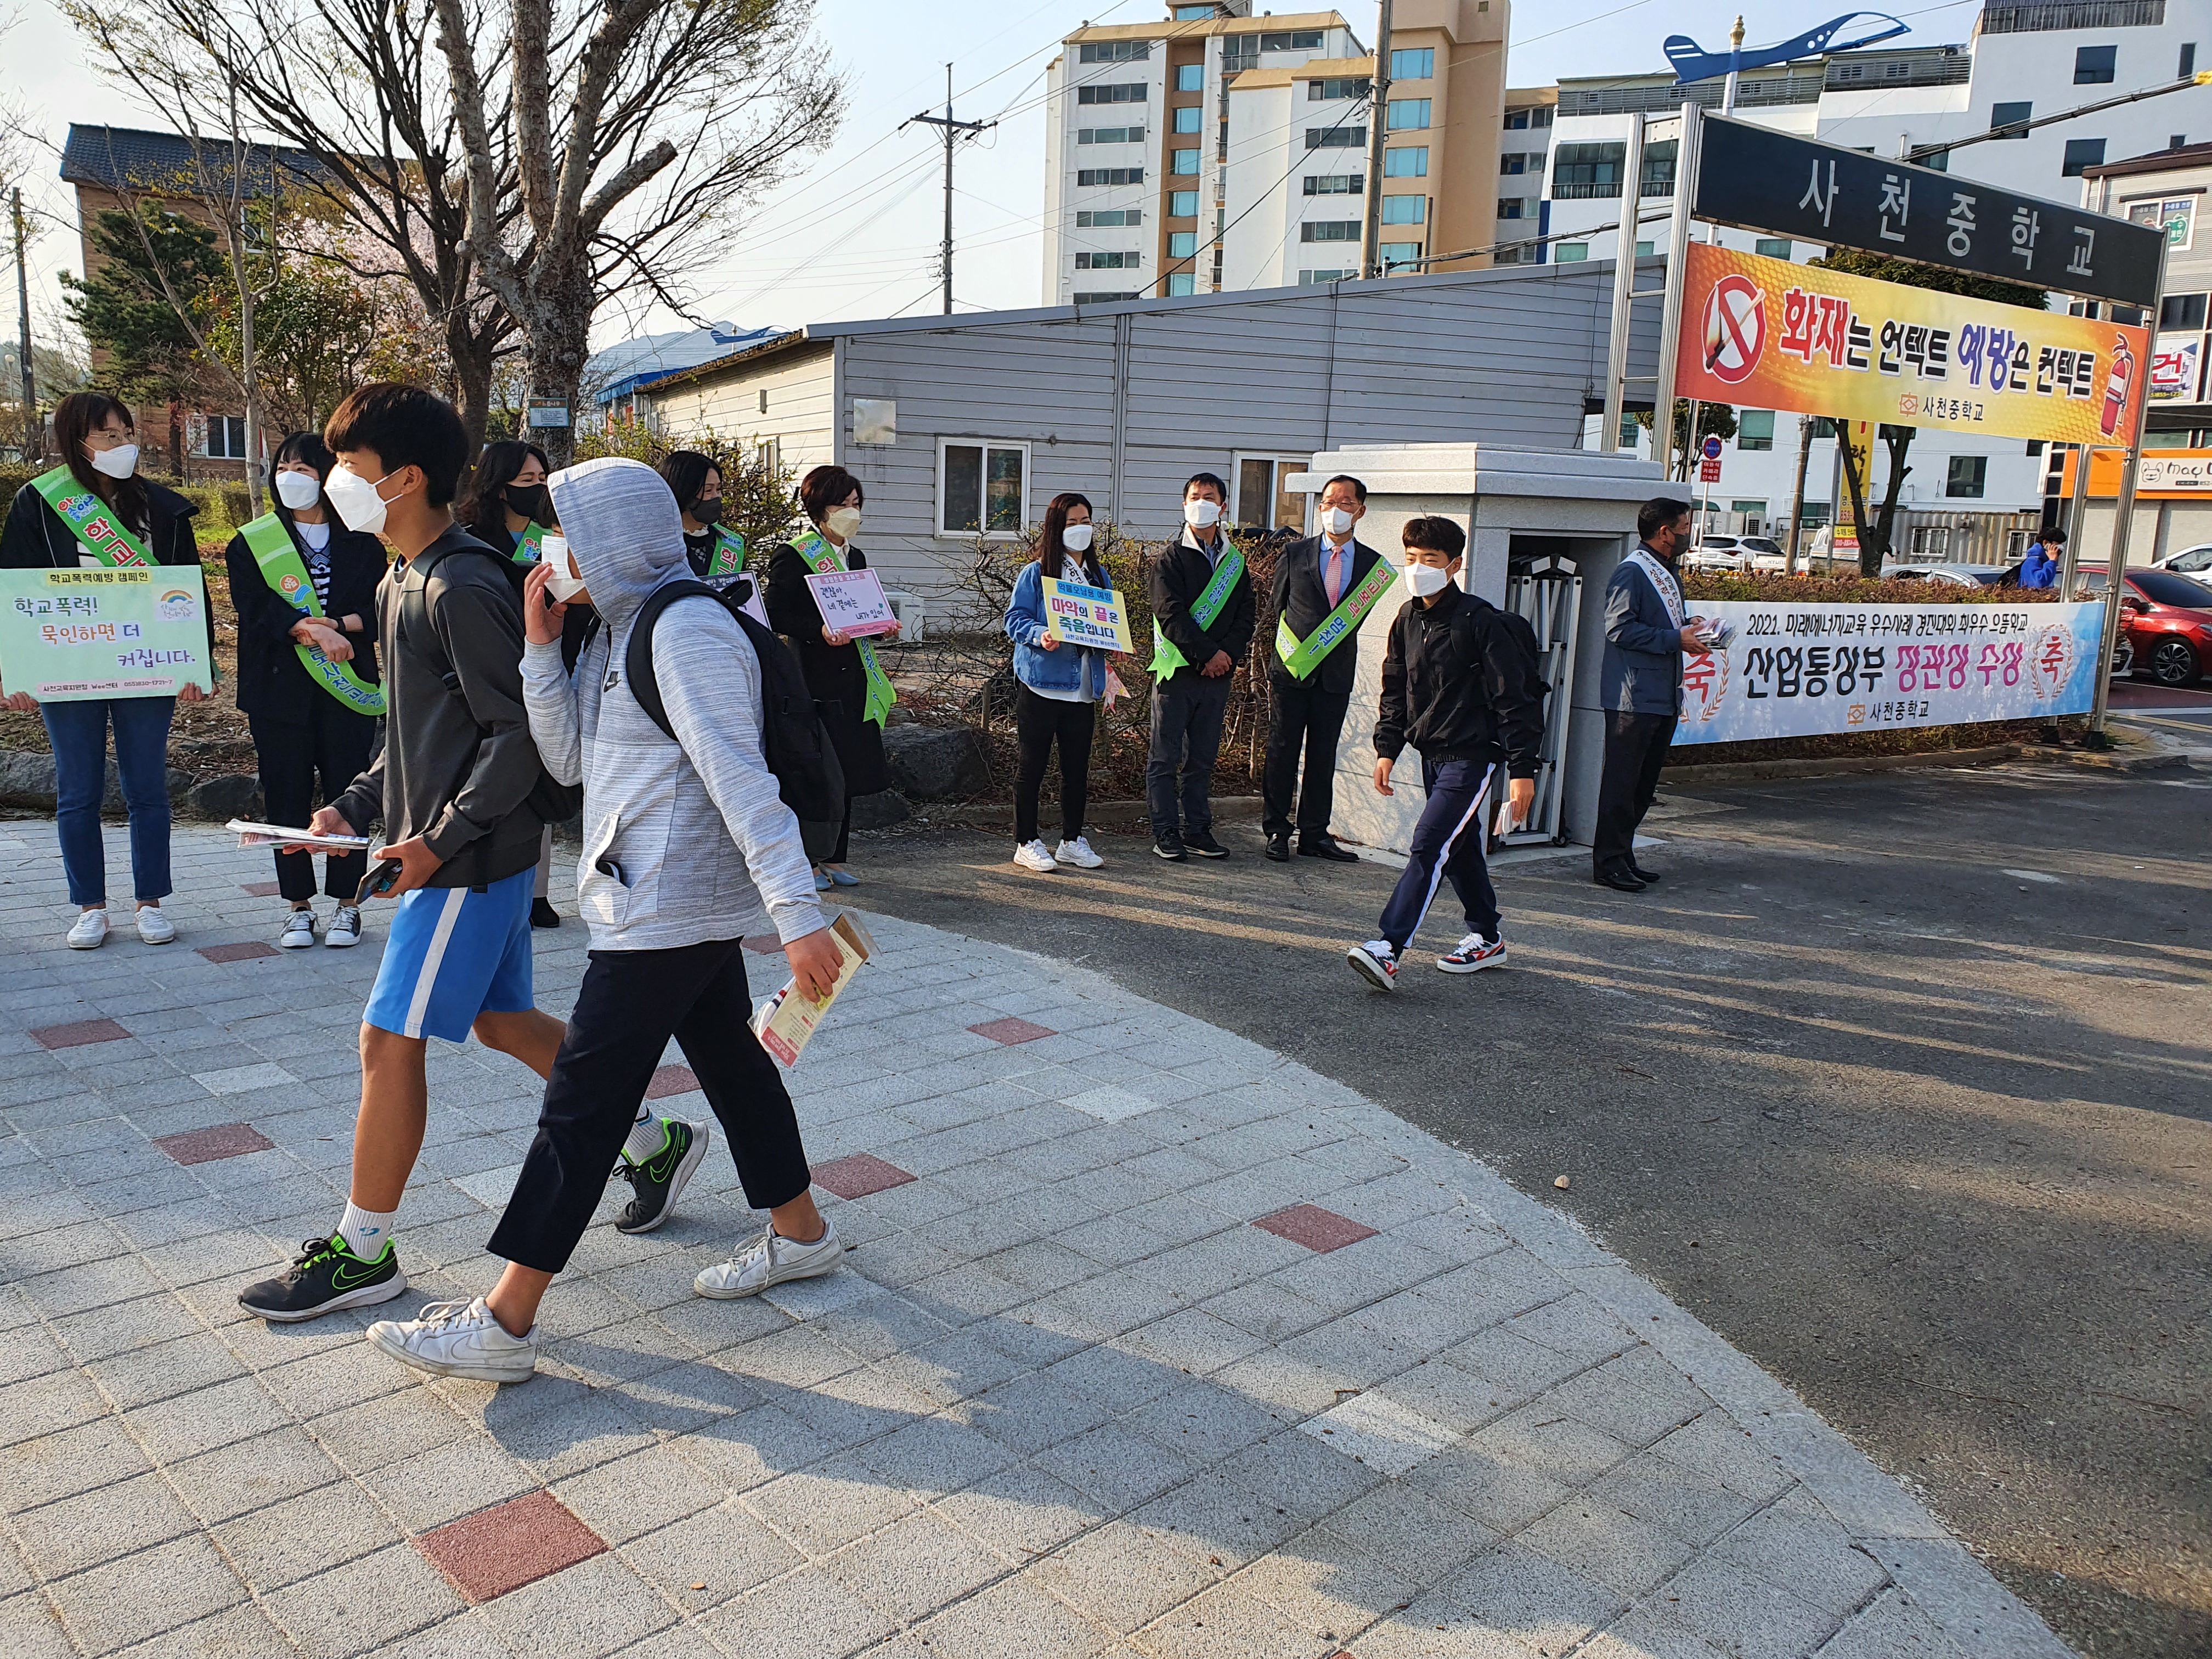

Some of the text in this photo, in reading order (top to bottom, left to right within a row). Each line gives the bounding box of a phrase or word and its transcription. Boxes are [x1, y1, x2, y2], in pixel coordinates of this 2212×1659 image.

[1799, 159, 2096, 276] 사천중학교
[1779, 288, 2096, 397] 화재는 언텍트 예방은 컨텍트
[1922, 396, 1984, 421] 사천중학교
[49, 572, 149, 584] 학교폭력예방 캠페인
[14, 597, 99, 618] 학교폭력!
[1097, 590, 1112, 602] 예방
[1051, 597, 1119, 624] 마약의 끝은
[1308, 568, 1390, 655] 학교폭력 멈춰!
[1667, 599, 1680, 626] OUT
[41, 623, 140, 645] 묵인하면 더
[1058, 615, 1115, 640] 죽음입니다
[1746, 613, 1780, 636] 2021.
[1785, 613, 1867, 637] 미래에너지교육
[1869, 613, 1914, 637] 우수사례
[1915, 613, 1957, 636] 경진대회
[1957, 612, 1989, 636] 최우수
[117, 648, 196, 668] 커집니다.
[1743, 645, 1886, 699] 산업통상부
[1976, 642, 2024, 687] 수상
[2040, 636, 2064, 684] 축
[1869, 699, 1931, 721] 사천중학교
